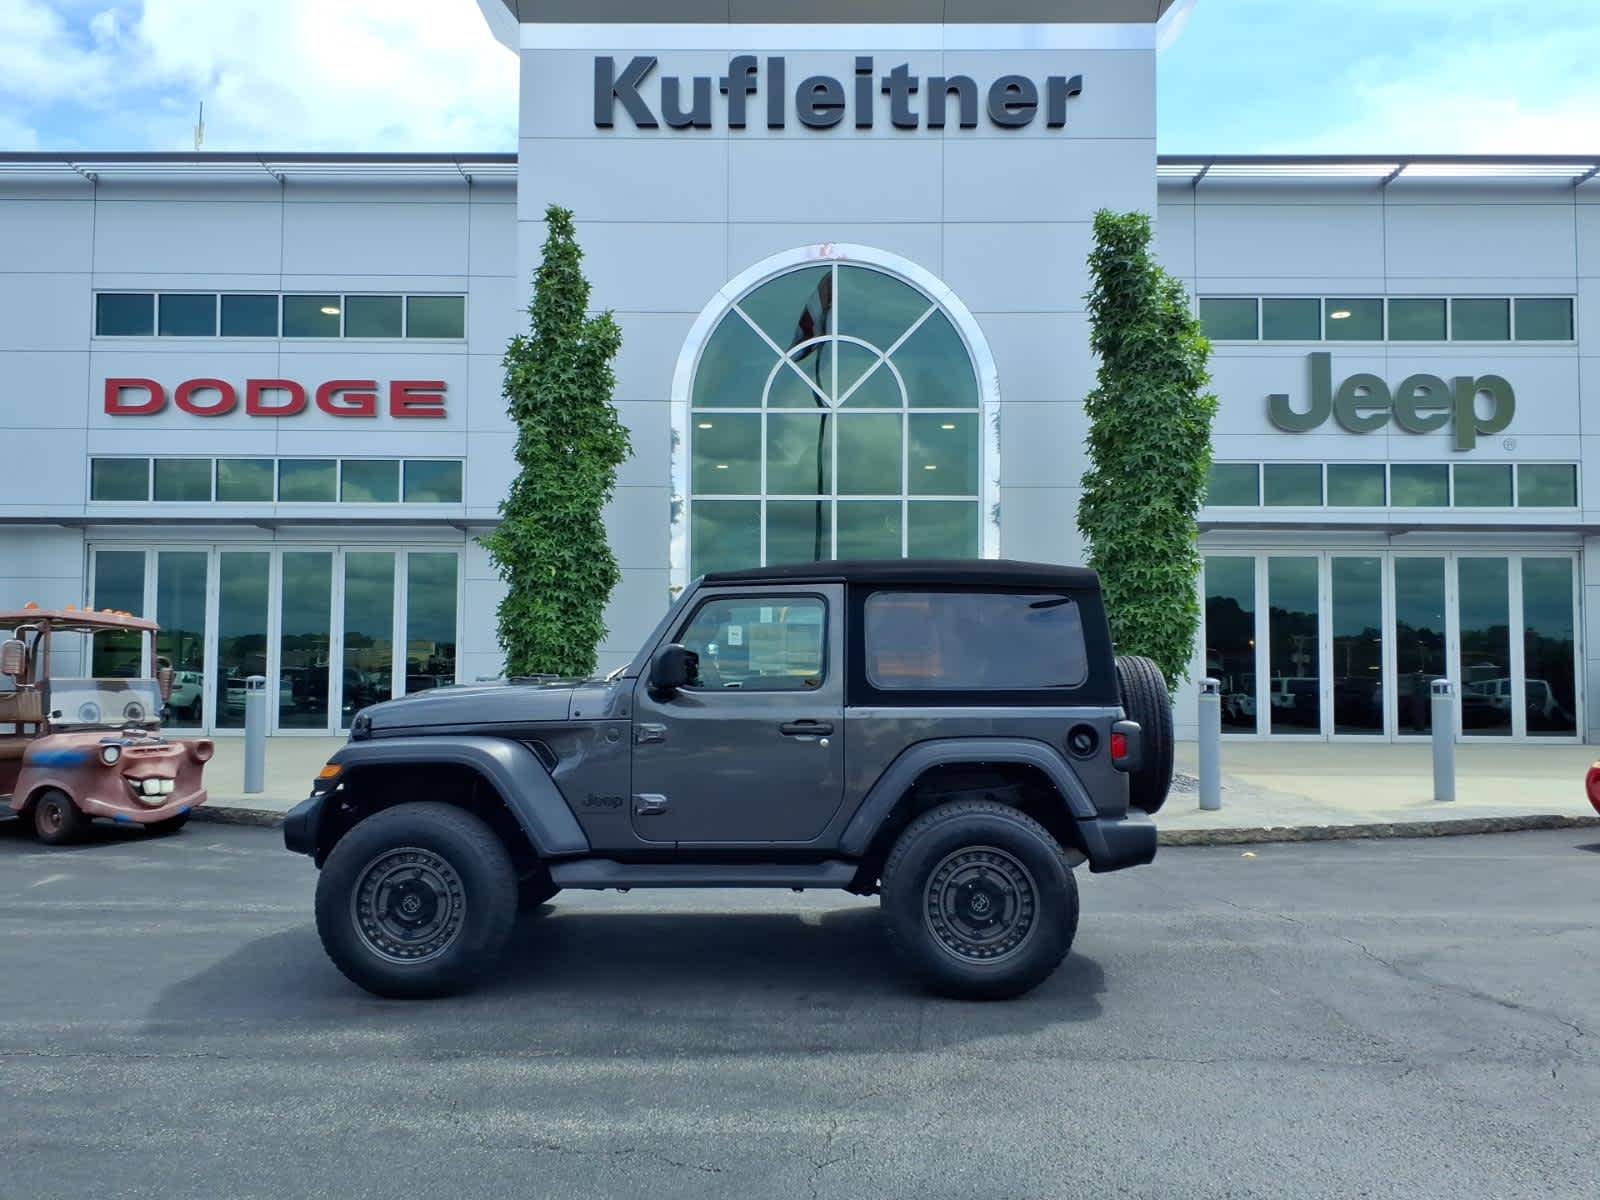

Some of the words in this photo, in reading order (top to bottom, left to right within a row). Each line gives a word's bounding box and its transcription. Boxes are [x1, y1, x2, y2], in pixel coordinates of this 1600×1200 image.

[594, 55, 1083, 130] Kufleitner
[104, 378, 448, 419] DODGE
[1267, 352, 1515, 451] Jeep
[582, 793, 623, 809] Jeep
